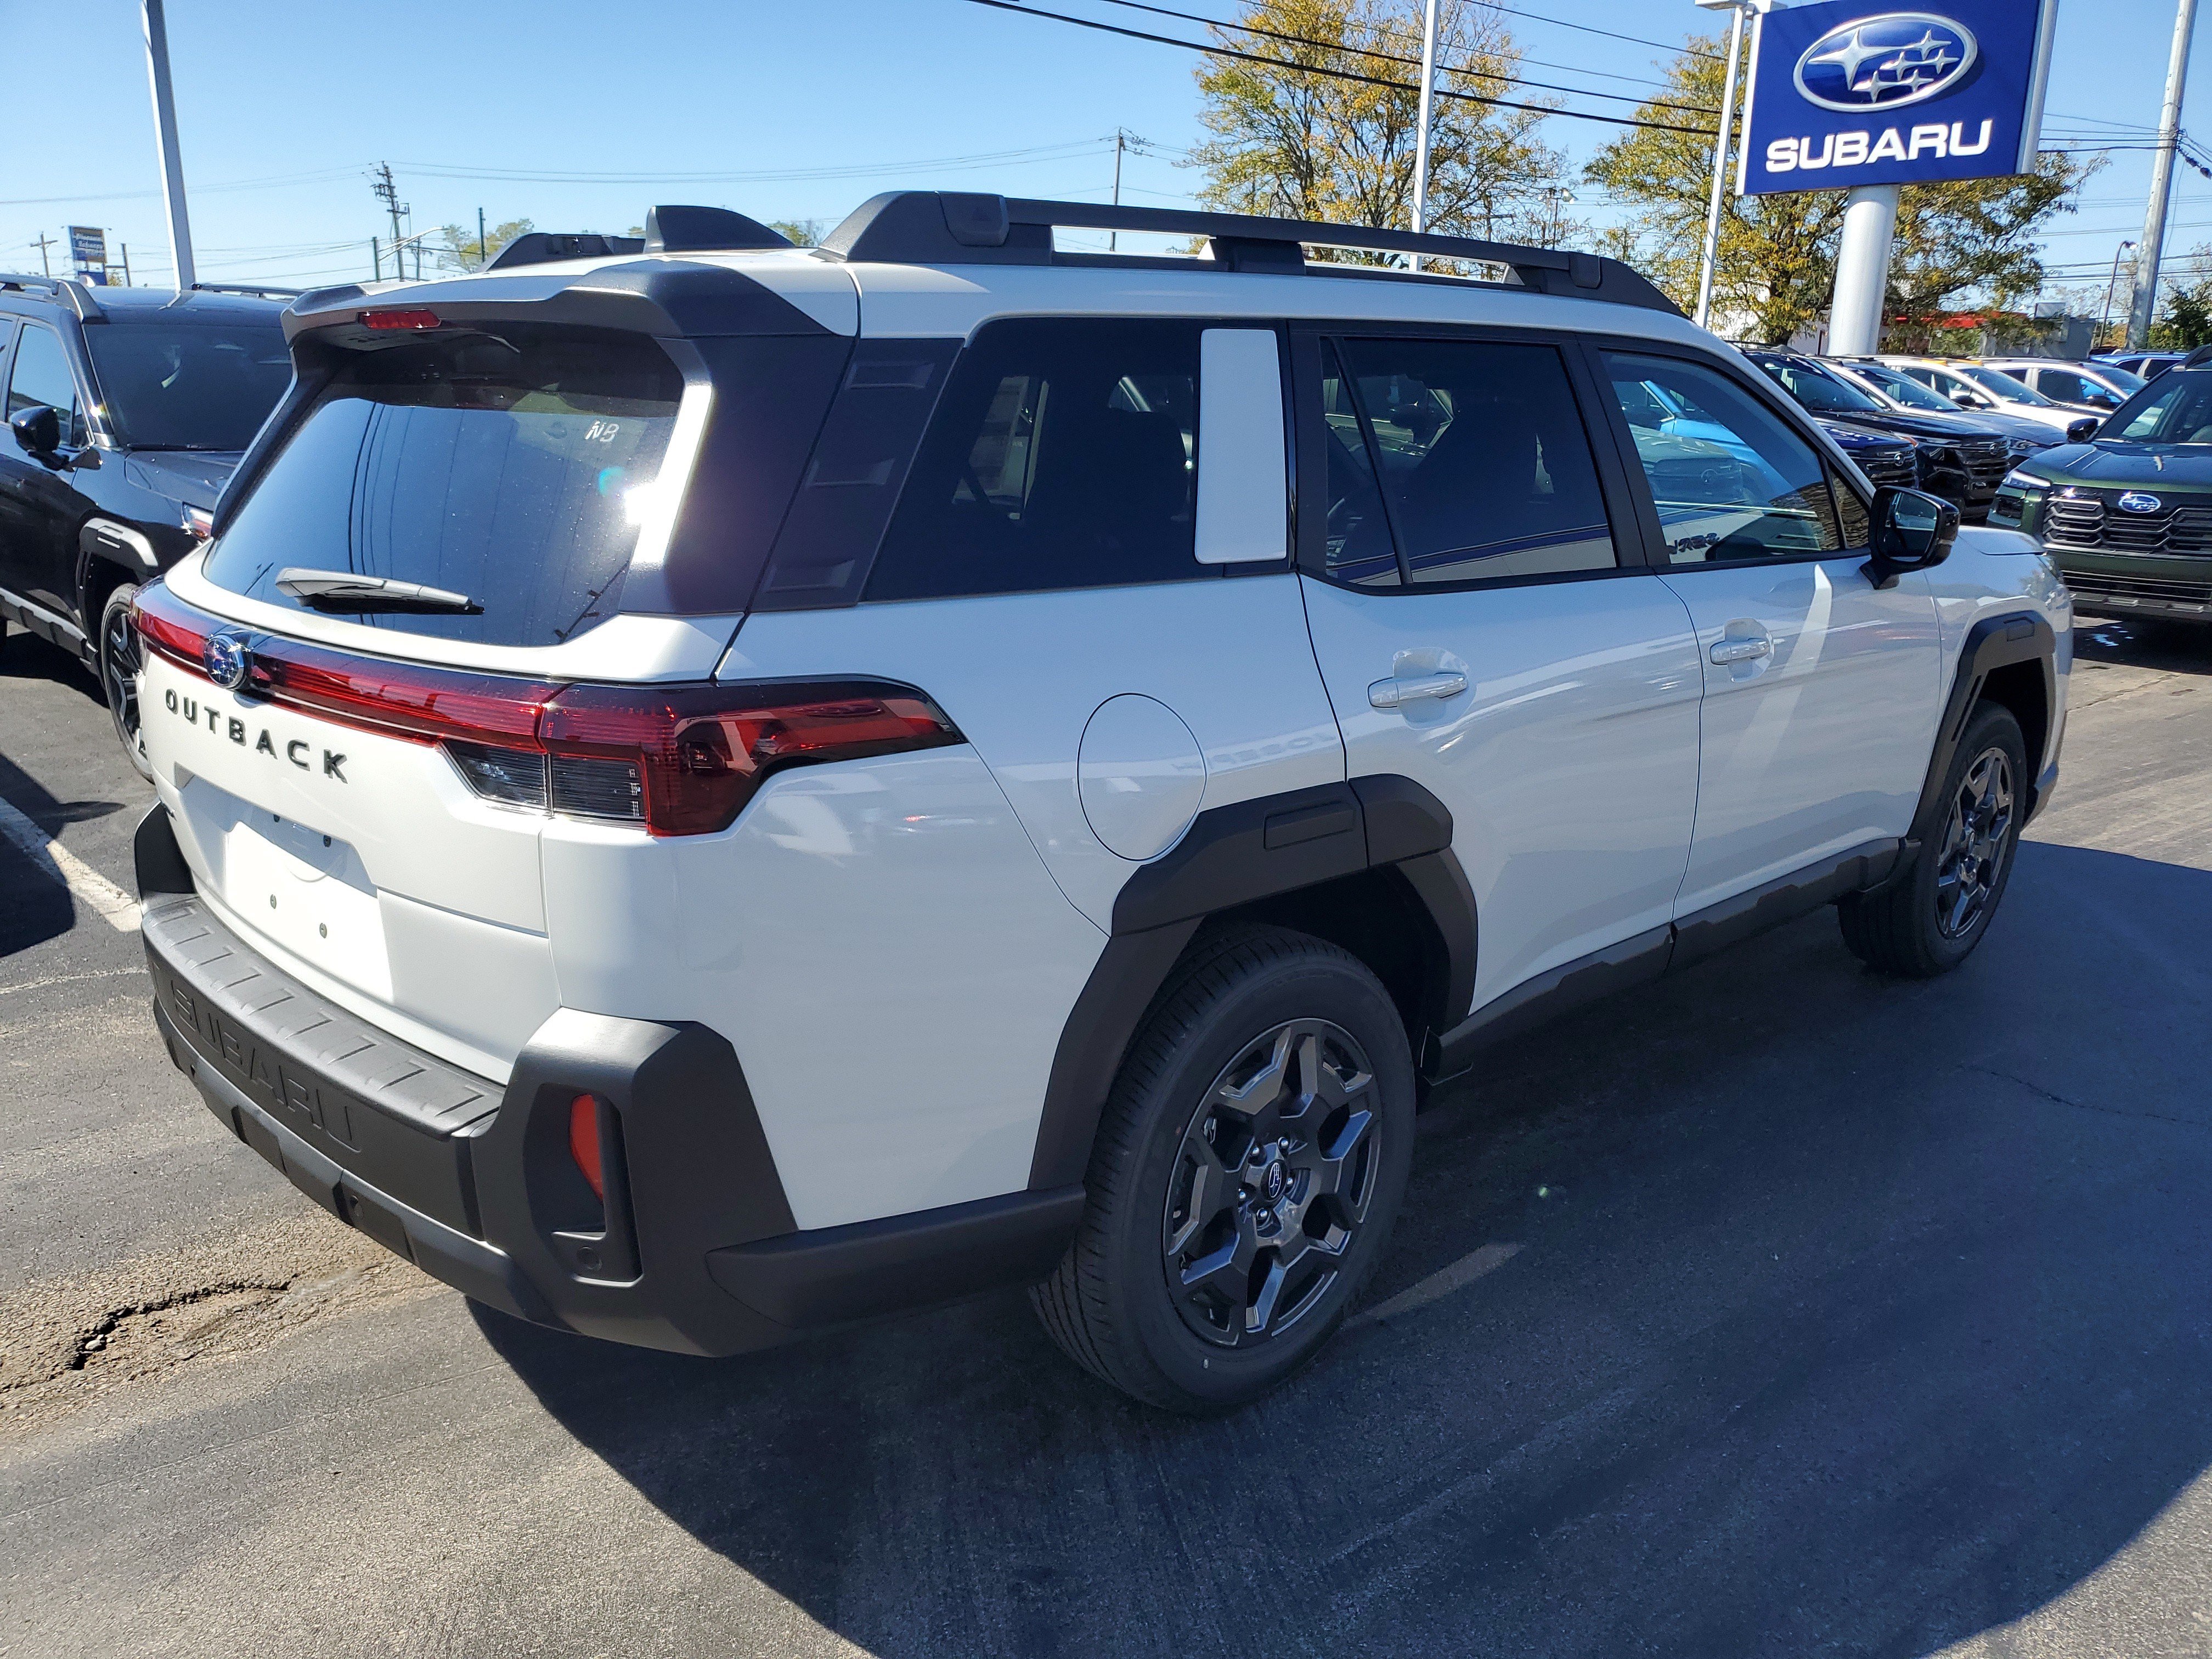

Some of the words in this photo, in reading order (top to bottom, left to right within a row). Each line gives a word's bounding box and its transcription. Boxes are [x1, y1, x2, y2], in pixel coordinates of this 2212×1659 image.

[1765, 119, 1993, 173] SUBARU
[585, 419, 620, 442] NB
[165, 688, 348, 784] OUTBACK
[171, 980, 362, 1153] SUBARU
